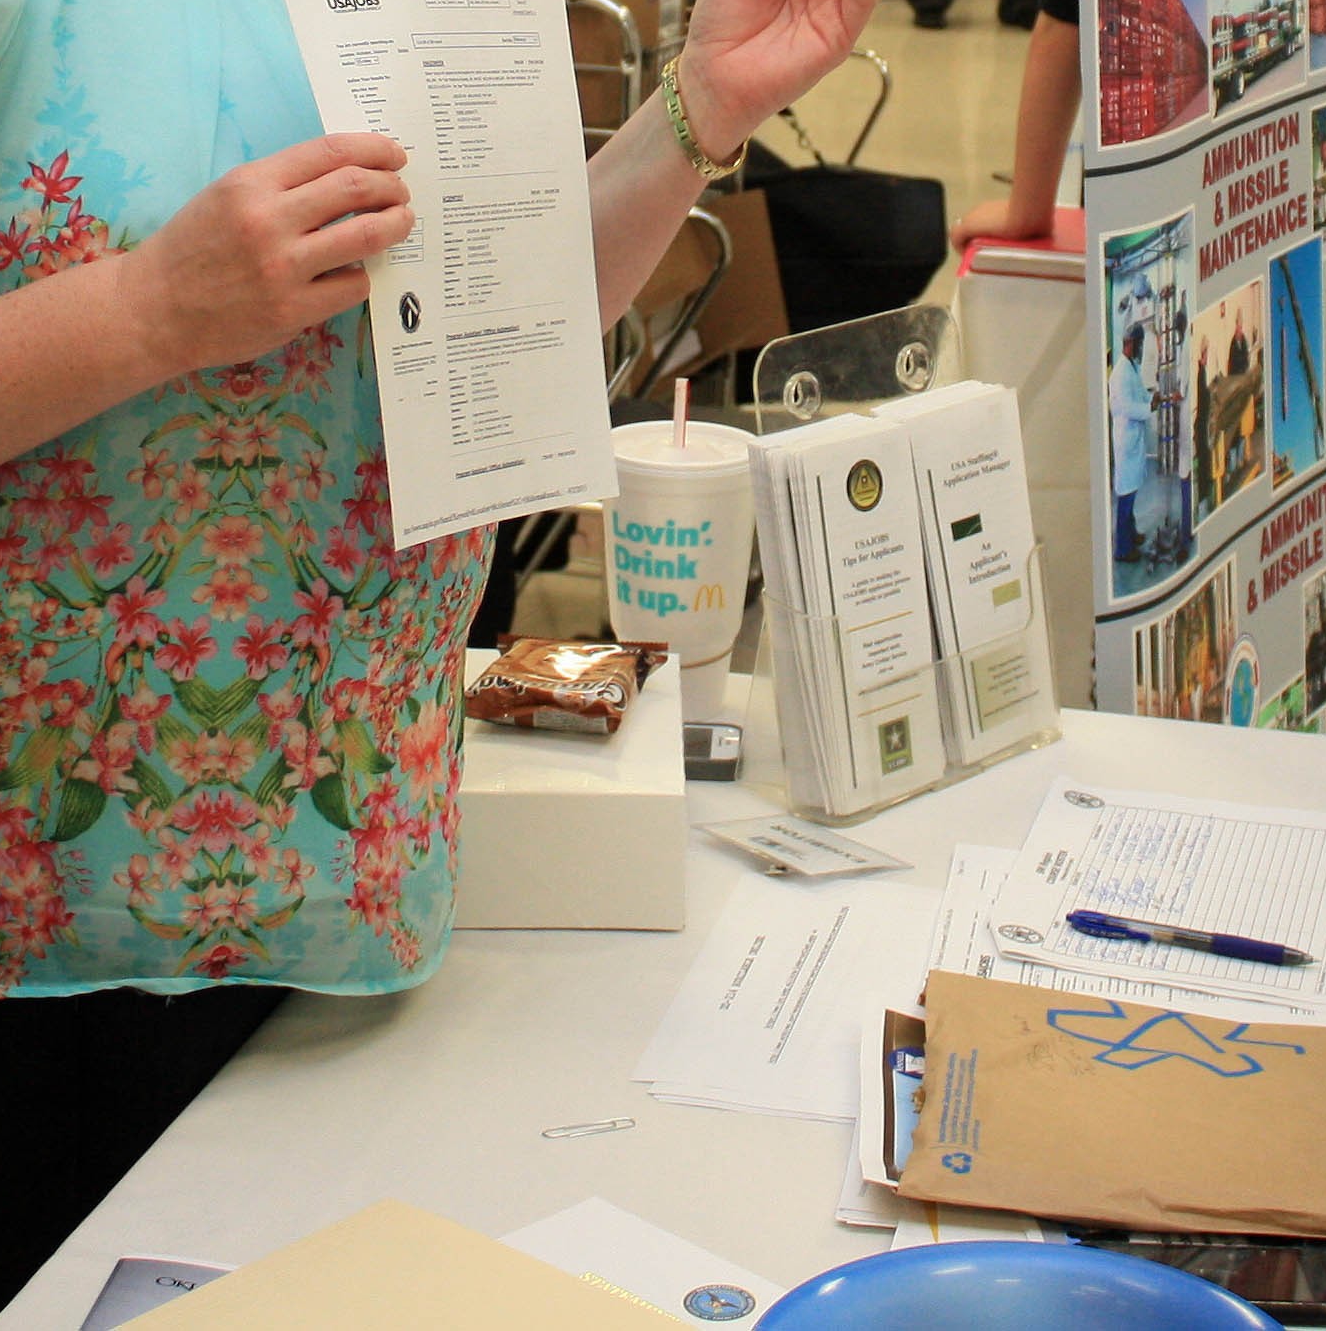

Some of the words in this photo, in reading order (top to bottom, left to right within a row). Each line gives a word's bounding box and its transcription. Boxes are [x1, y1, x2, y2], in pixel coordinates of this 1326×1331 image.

[1203, 112, 1300, 189] AMMUNITION
[1213, 191, 1224, 227] &
[1227, 159, 1289, 222] MISSILE
[1199, 193, 1308, 283] MAINTENANCE
[614, 543, 697, 580] Drink
[616, 574, 631, 604] it
[638, 589, 688, 618] up.
[1246, 581, 1257, 614] &
[1263, 529, 1324, 603] MISSILE
